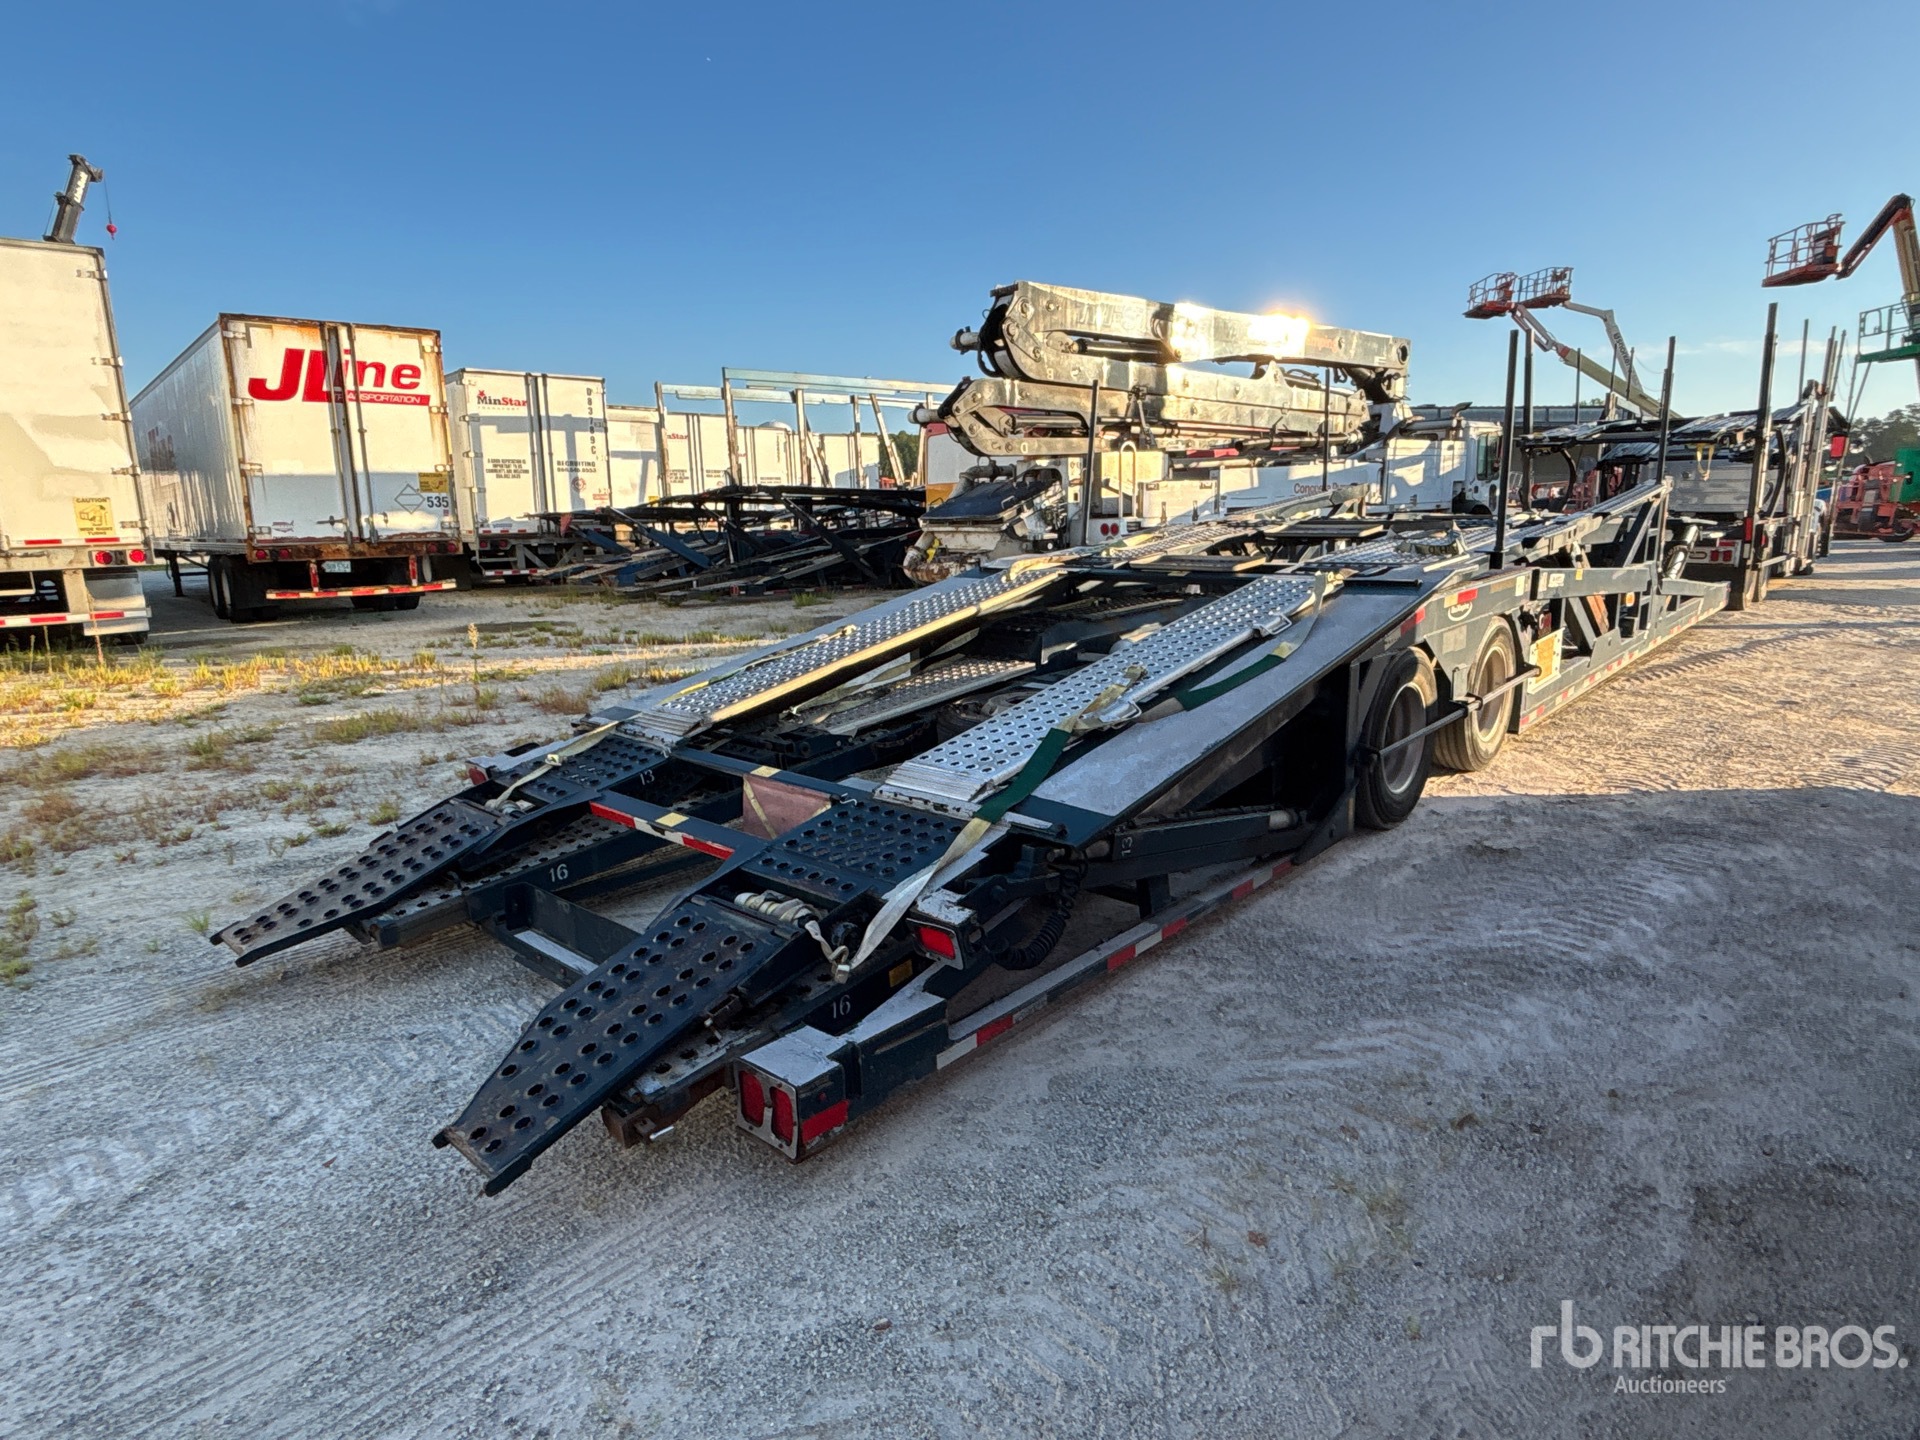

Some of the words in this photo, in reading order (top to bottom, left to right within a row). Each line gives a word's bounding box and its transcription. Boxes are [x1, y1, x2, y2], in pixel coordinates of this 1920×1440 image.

[334, 391, 421, 404] TRASPORTATION
[476, 396, 528, 407] MinStar
[426, 496, 450, 508] 535
[640, 769, 655, 786] 13
[549, 863, 569, 883] 16
[832, 994, 851, 1019] 16
